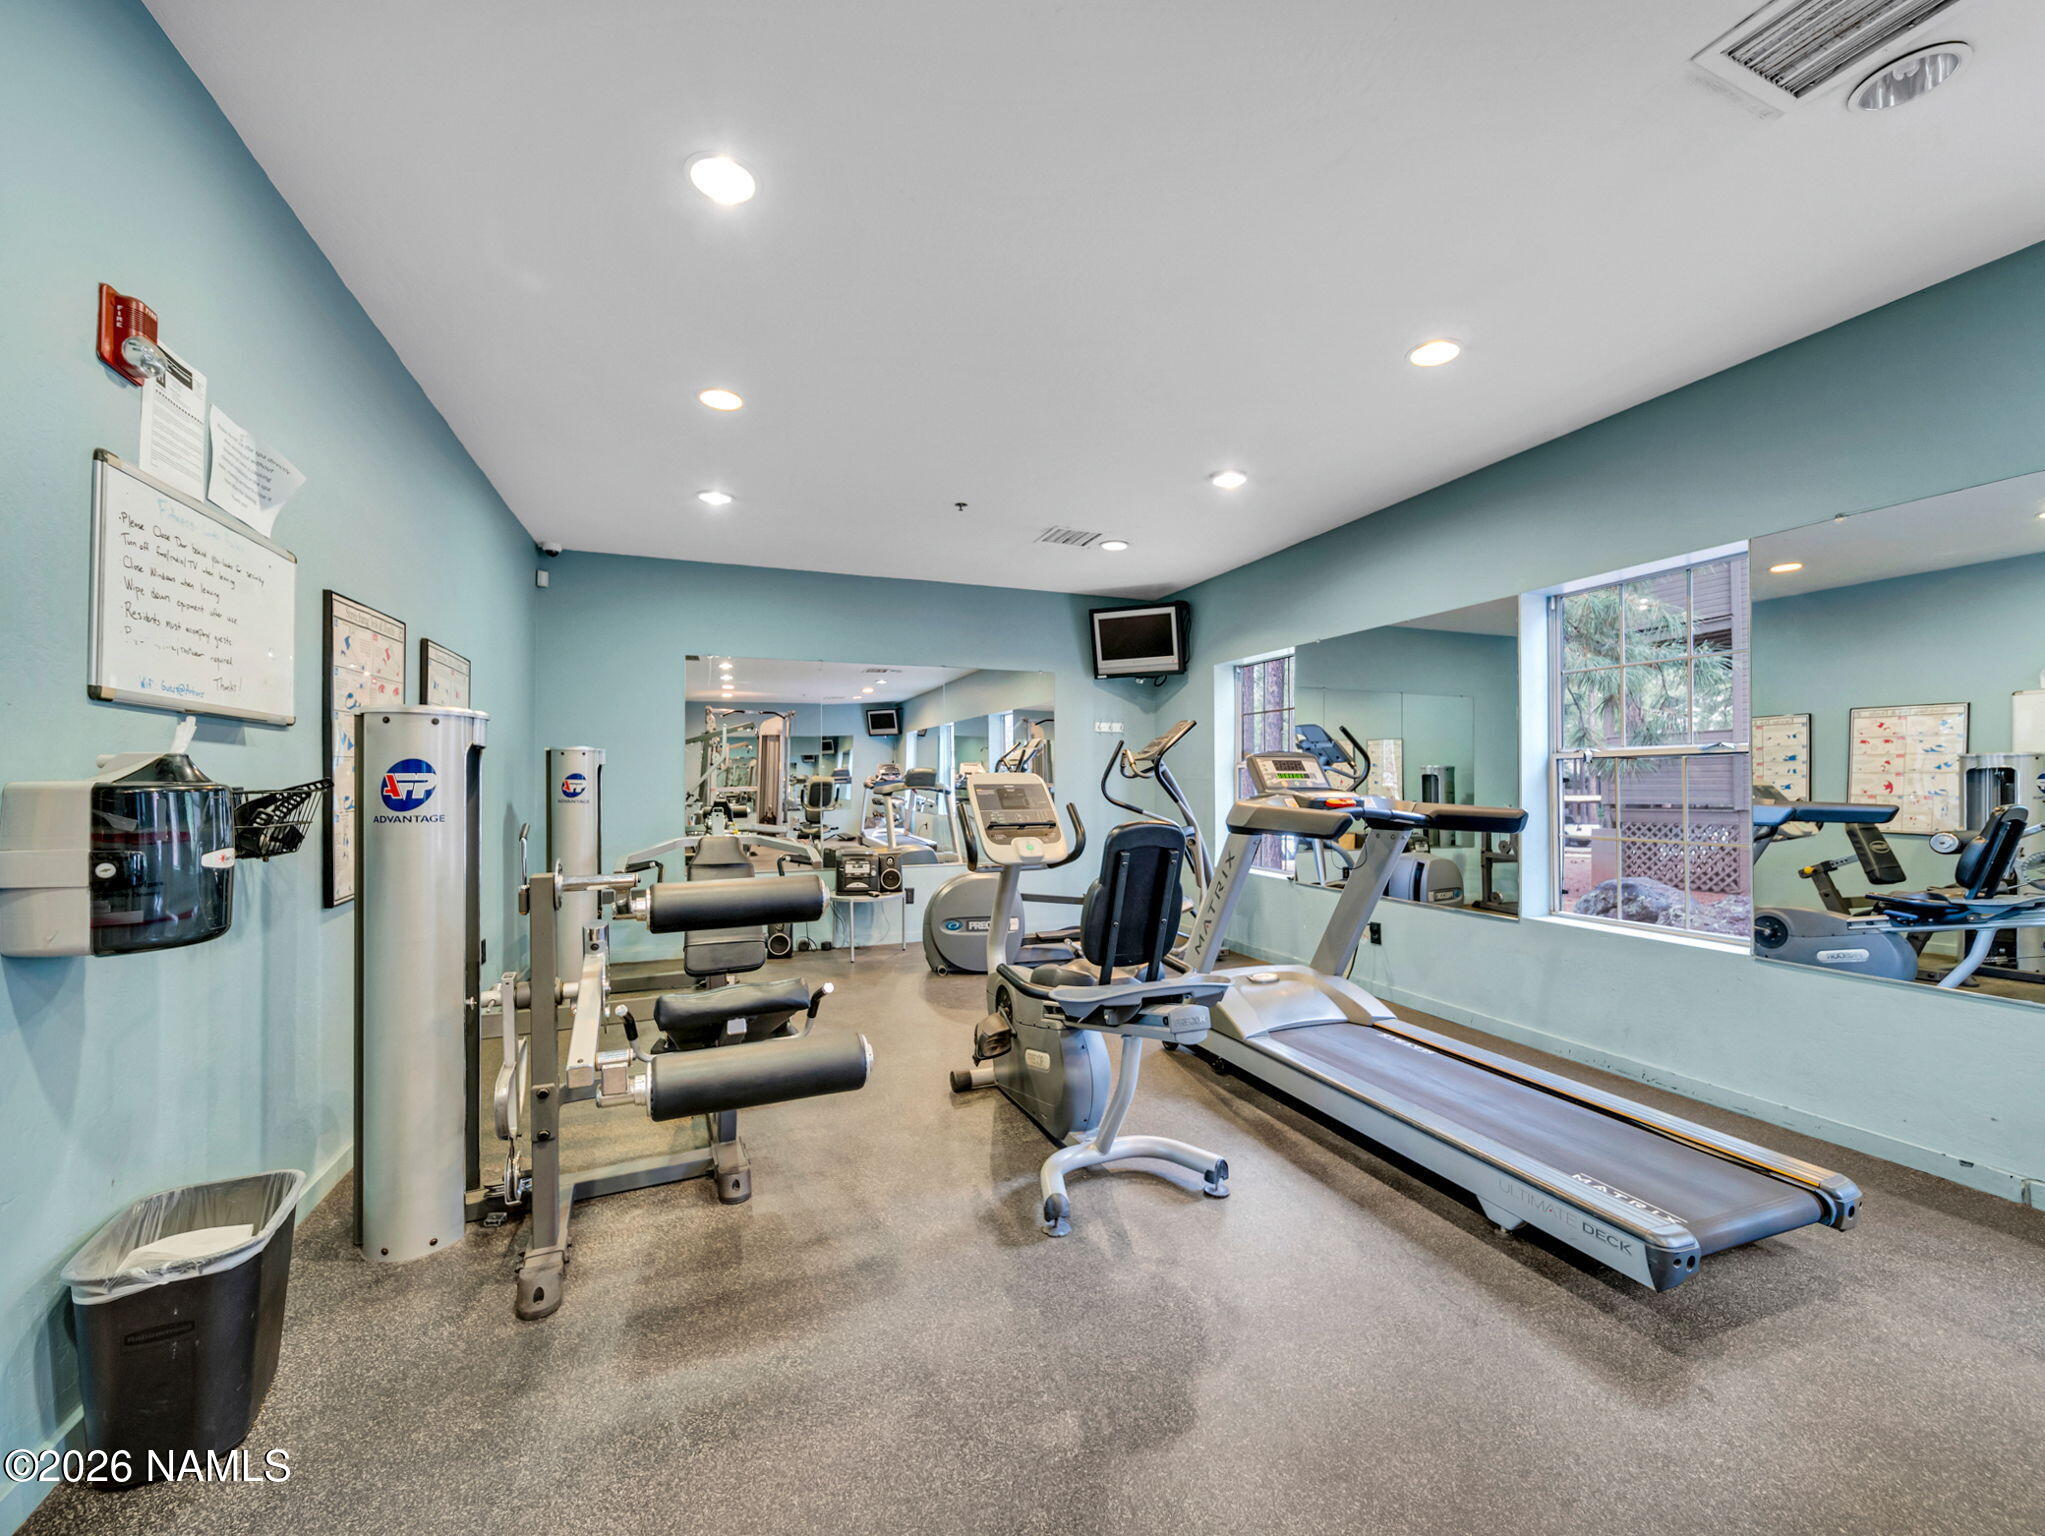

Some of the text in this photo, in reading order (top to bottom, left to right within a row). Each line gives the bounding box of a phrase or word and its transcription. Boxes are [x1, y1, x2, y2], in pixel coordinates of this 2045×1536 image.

[122, 554, 144, 573] Close
[123, 576, 145, 600] Wipe
[373, 814, 446, 823] ADVANTAGE
[1194, 849, 1236, 956] MATRIX
[968, 920, 991, 930] PREC
[1571, 1173, 1681, 1225] MATRIX
[1499, 1180, 1633, 1256] ULTIMATE DECK
